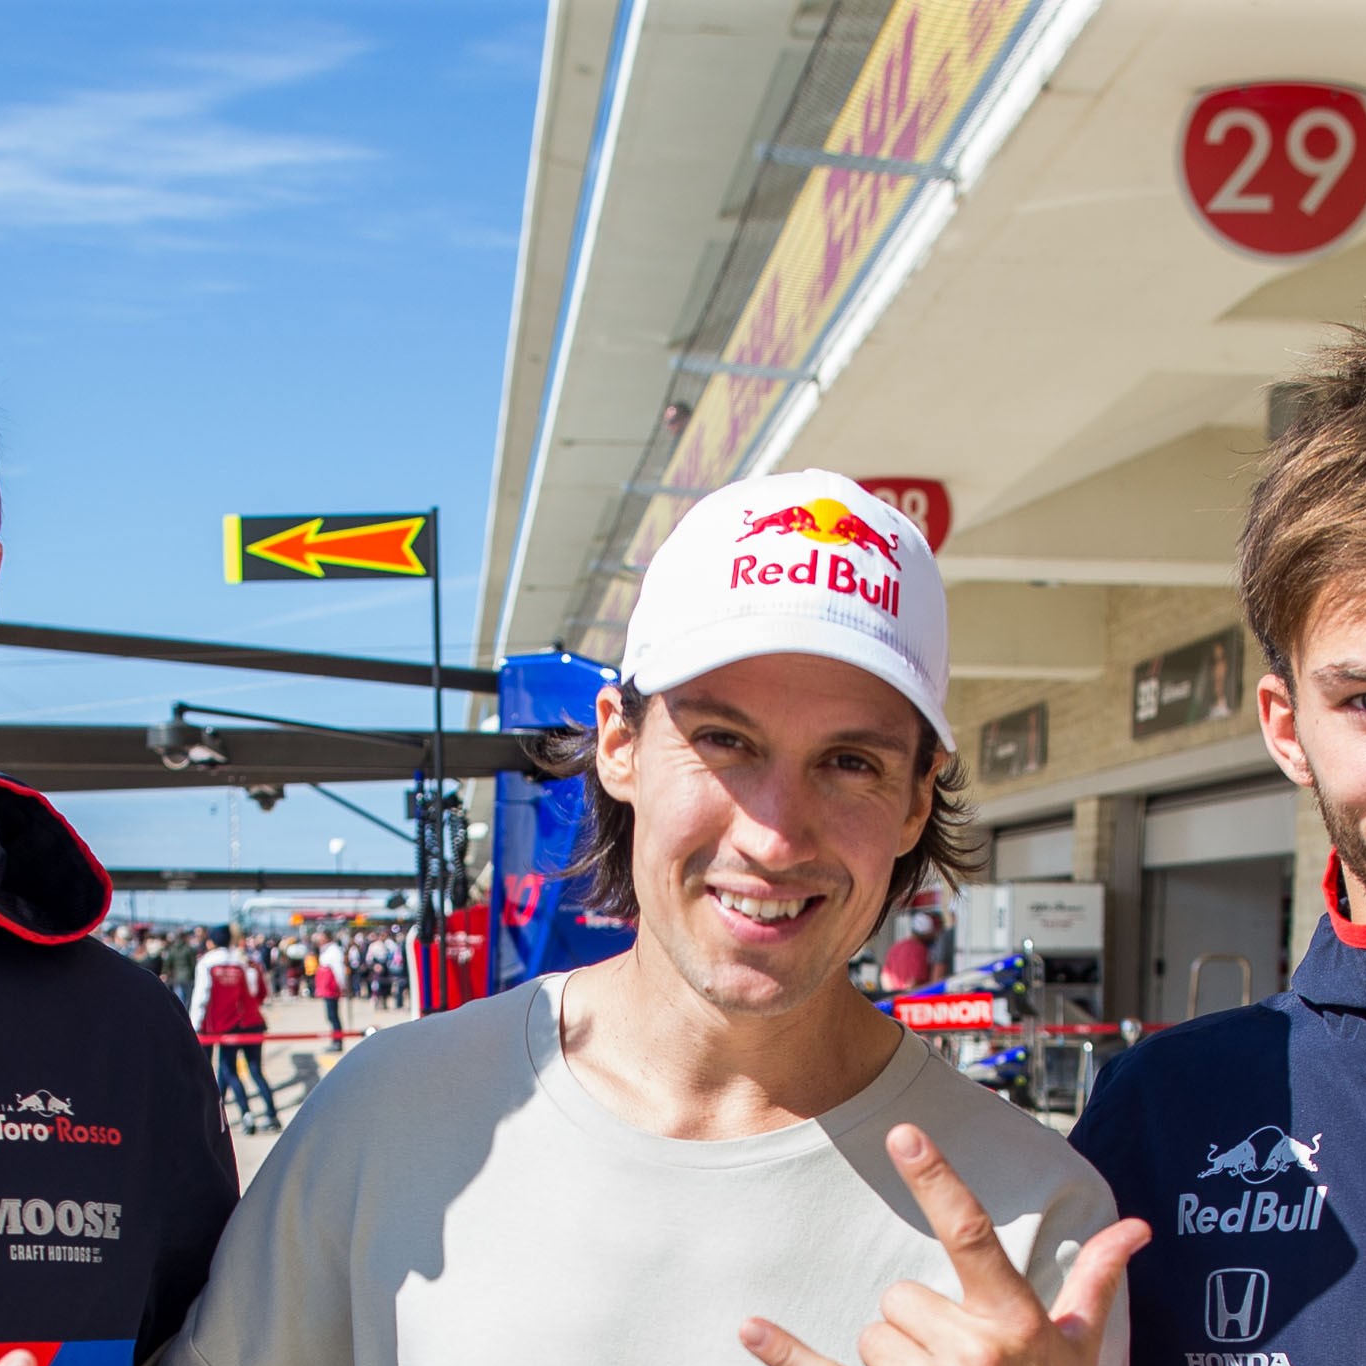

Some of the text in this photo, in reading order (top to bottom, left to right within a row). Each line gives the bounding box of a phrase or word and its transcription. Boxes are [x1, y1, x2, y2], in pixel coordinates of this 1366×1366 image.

[1203, 107, 1357, 215] 29
[730, 549, 900, 618] Red Bull
[504, 873, 545, 926] 10
[55, 1116, 122, 1145] Rosso
[1178, 1186, 1328, 1235] Red Bull
[9, 1244, 45, 1261] CRAFT
[48, 1245, 91, 1263] HOTDOGS
